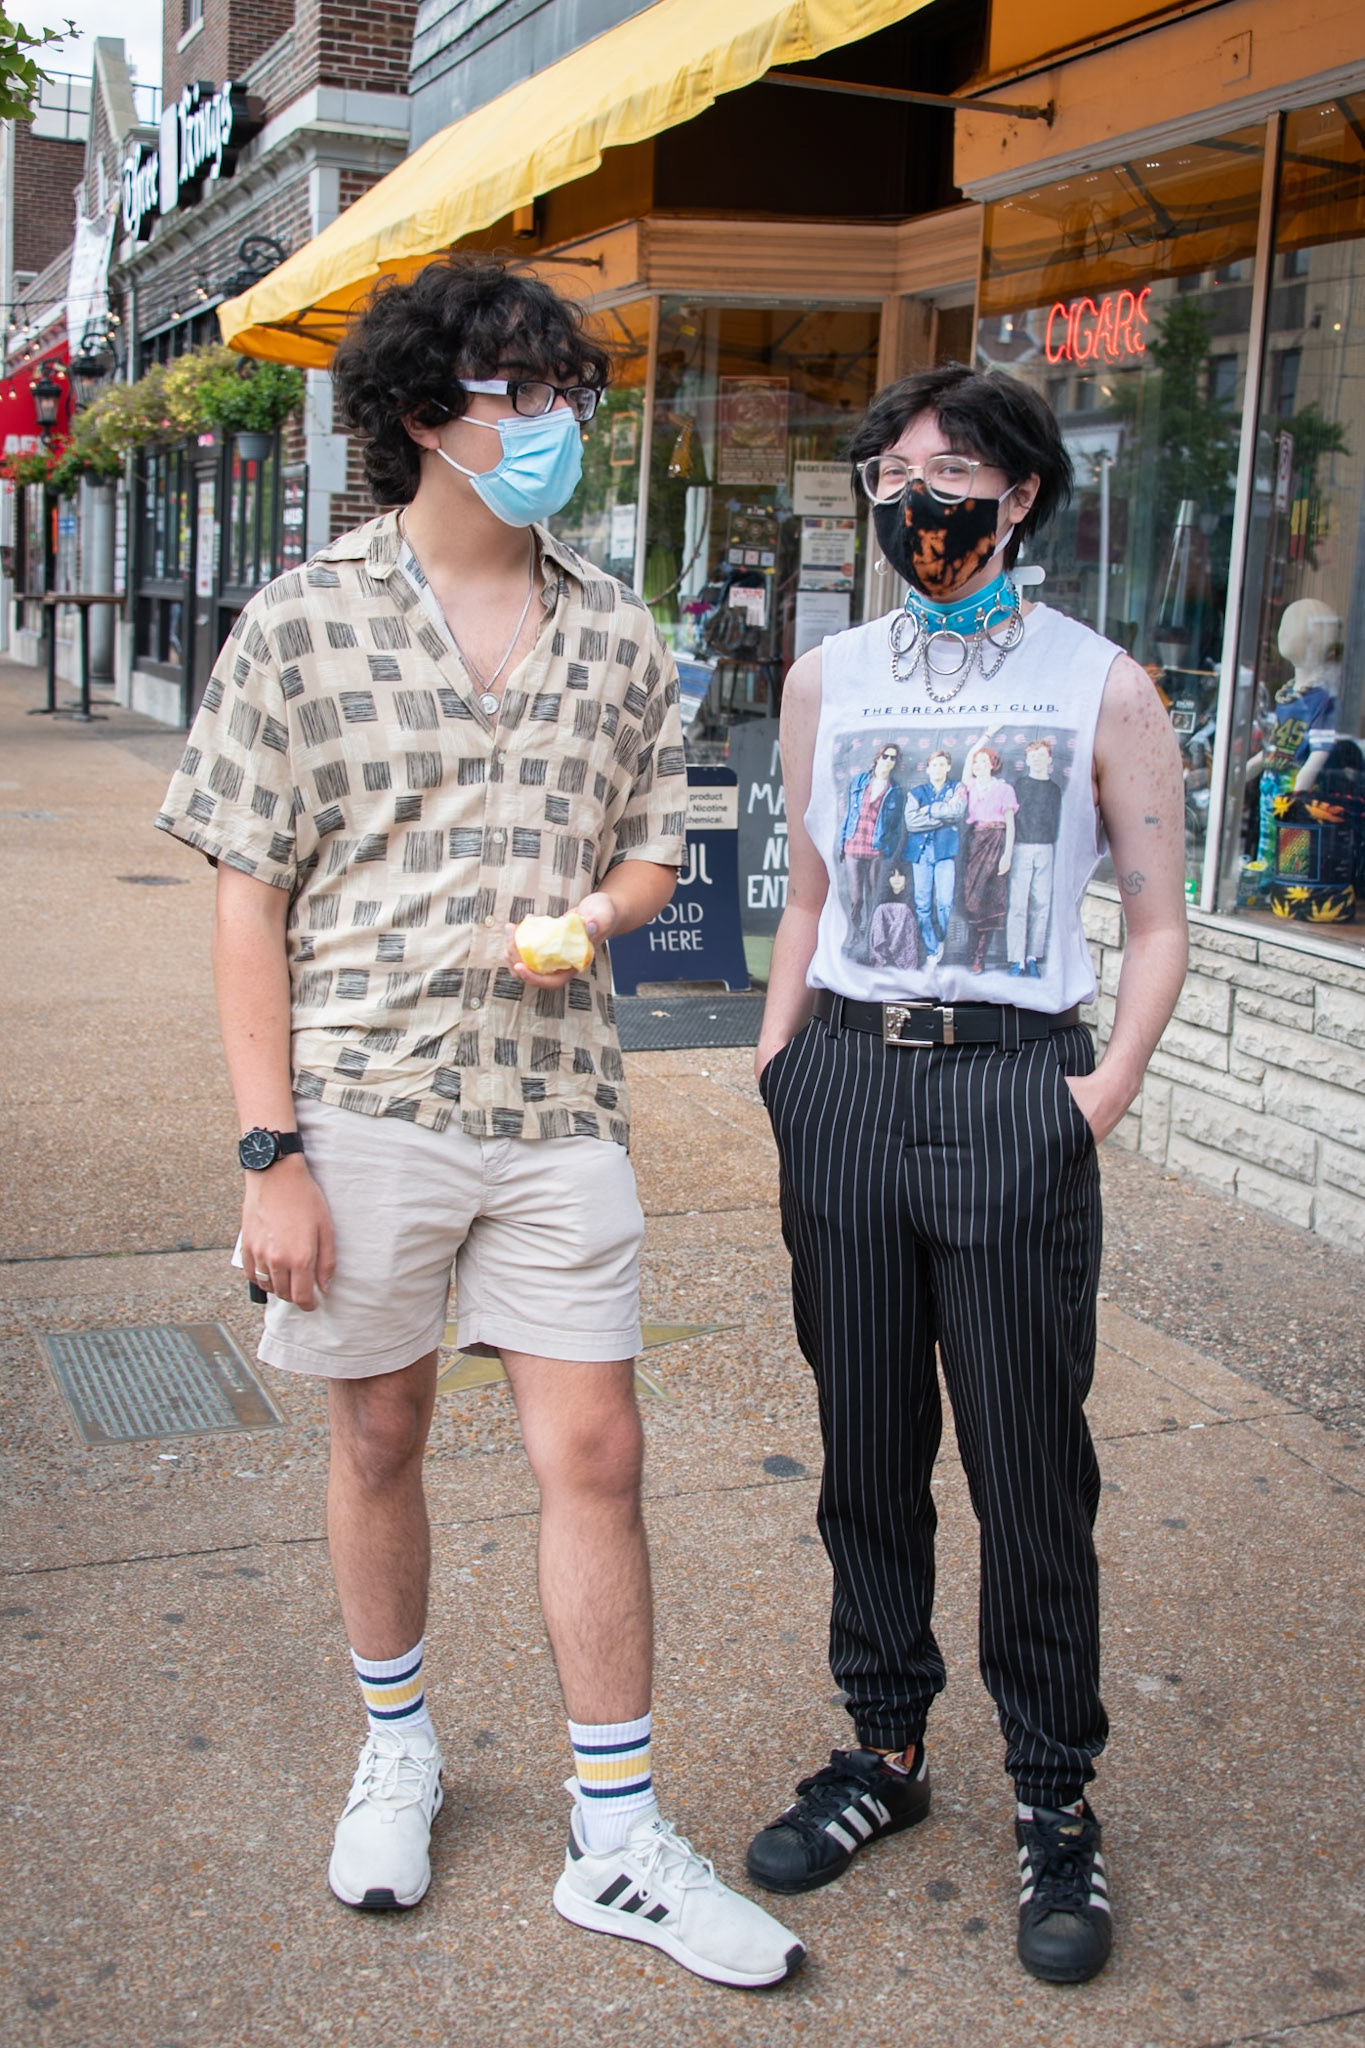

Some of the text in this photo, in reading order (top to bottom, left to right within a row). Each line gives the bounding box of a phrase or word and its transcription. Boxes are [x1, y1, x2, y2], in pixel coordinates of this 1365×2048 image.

[862, 707, 893, 716] THE
[900, 703, 1000, 715] BREAKFAST
[689, 792, 723, 803] product
[747, 782, 787, 815] MA
[693, 804, 728, 812] Nicotine
[747, 875, 789, 908] ENT
[649, 929, 704, 952] HERE
